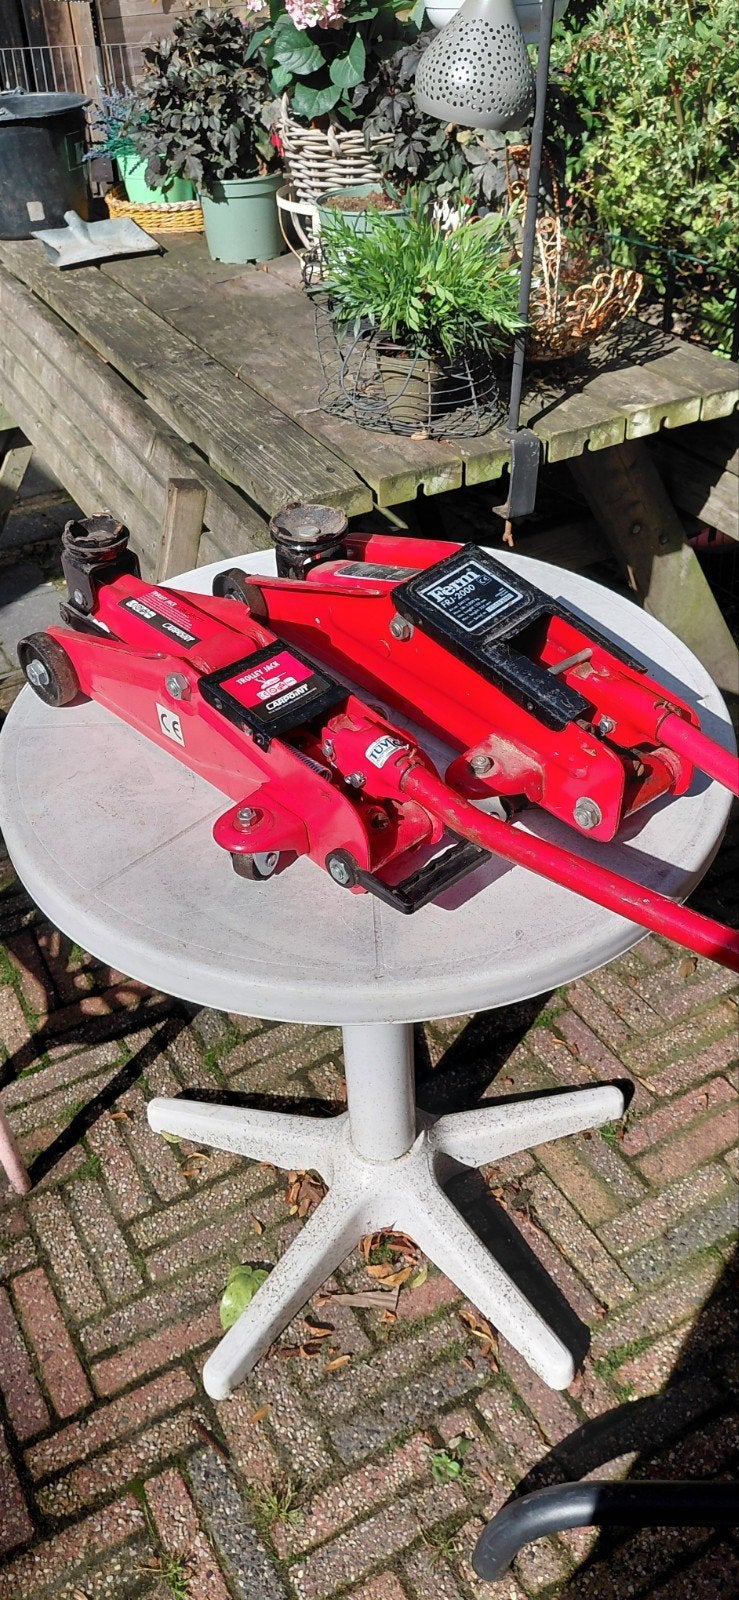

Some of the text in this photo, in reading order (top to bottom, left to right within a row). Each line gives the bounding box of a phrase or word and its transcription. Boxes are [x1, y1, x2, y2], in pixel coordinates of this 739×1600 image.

[427, 570, 481, 603] Ferm
[441, 584, 475, 609] FRJ-2000
[236, 670, 262, 685] TROLLEY
[264, 661, 281, 672] JACK
[161, 713, 182, 740] CE
